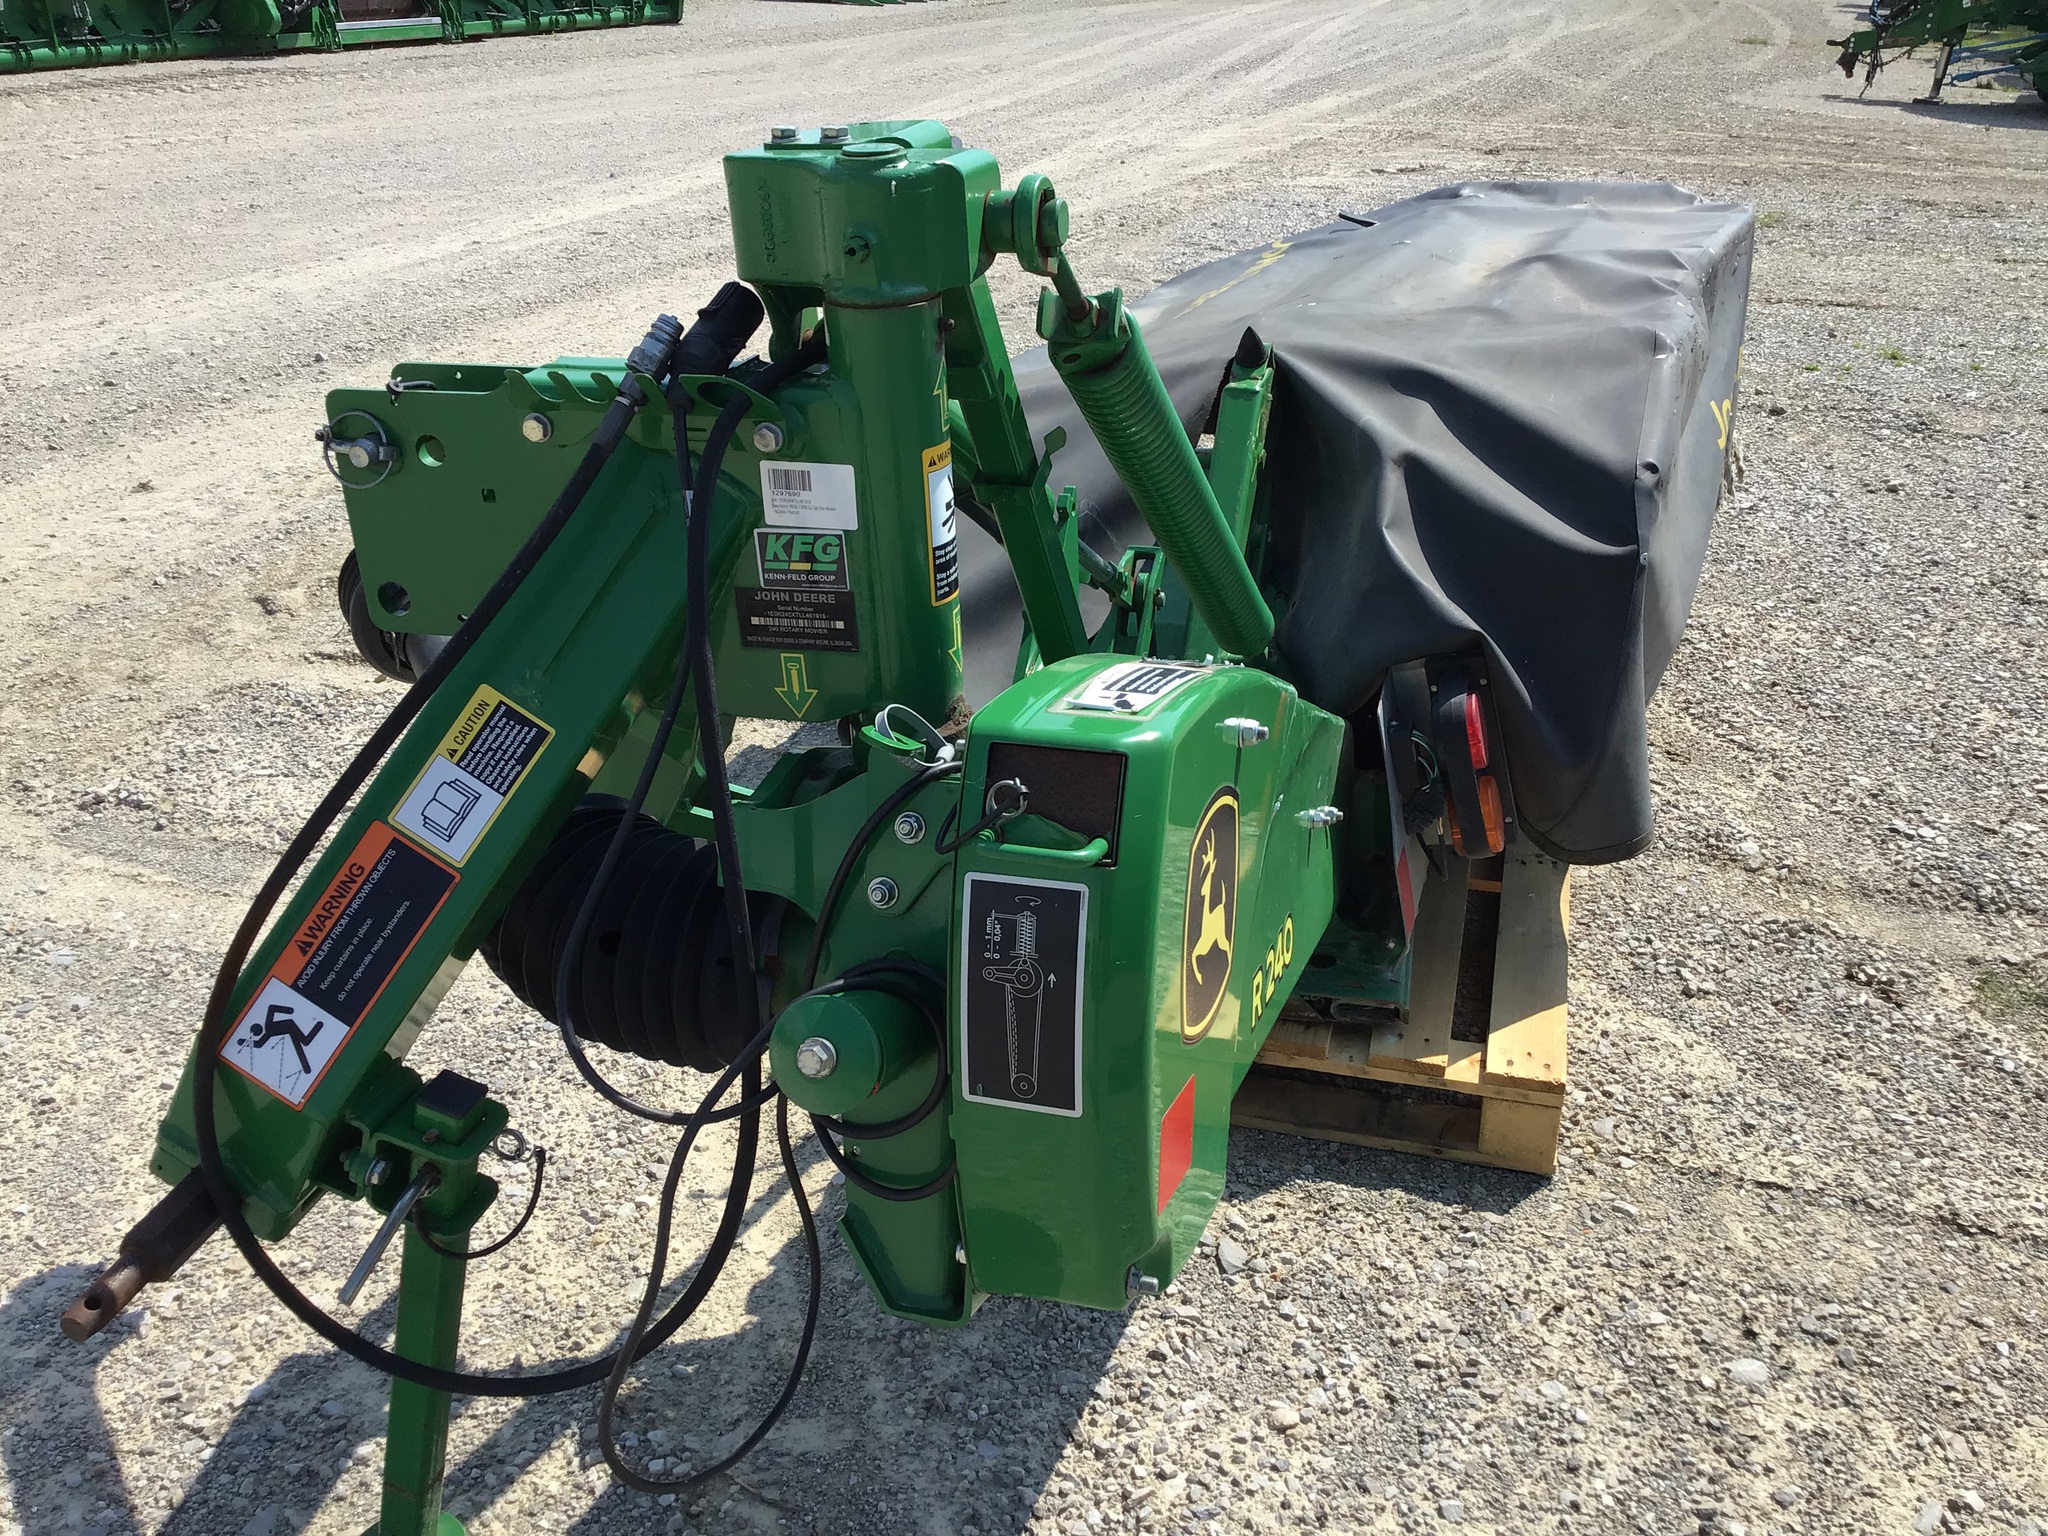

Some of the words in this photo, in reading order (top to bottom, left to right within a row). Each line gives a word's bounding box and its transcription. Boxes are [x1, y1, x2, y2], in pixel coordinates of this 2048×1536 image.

[765, 534, 840, 562] KFG
[754, 591, 789, 600] JOHN
[793, 592, 835, 603] DEERE
[808, 574, 835, 582] GROUP
[454, 700, 489, 746] CAUTION
[460, 751, 473, 767] Read
[472, 726, 491, 752] operator
[489, 704, 506, 726] manual
[466, 752, 482, 772] before
[479, 727, 500, 752] handling
[498, 717, 507, 727] the
[473, 749, 494, 776] machine.
[491, 725, 511, 749] Request
[480, 766, 493, 781] copy
[494, 749, 503, 760] not
[502, 723, 522, 750] supplied.
[486, 760, 505, 784] Observe
[503, 726, 529, 760] instructions
[493, 777, 503, 789] and
[501, 759, 516, 777] safety
[514, 743, 526, 758] rules
[524, 728, 537, 744] when
[500, 763, 522, 793] operating.
[297, 964, 316, 988] AVOID
[312, 938, 334, 965] INJURY
[331, 916, 349, 939] FROM
[346, 882, 373, 916] THROWN
[369, 848, 396, 883] OBJECTS
[305, 863, 365, 941] WARNING
[986, 917, 992, 933] mm
[320, 971, 337, 990] Keep
[333, 944, 354, 971] curtains
[357, 915, 374, 937] place.
[337, 991, 347, 1001] do
[344, 979, 355, 991] not
[353, 953, 373, 980] operate
[371, 937, 384, 953] near
[381, 899, 410, 938] bystanders.
[1251, 965, 1263, 1032] R
[1265, 912, 1293, 1007] 240
